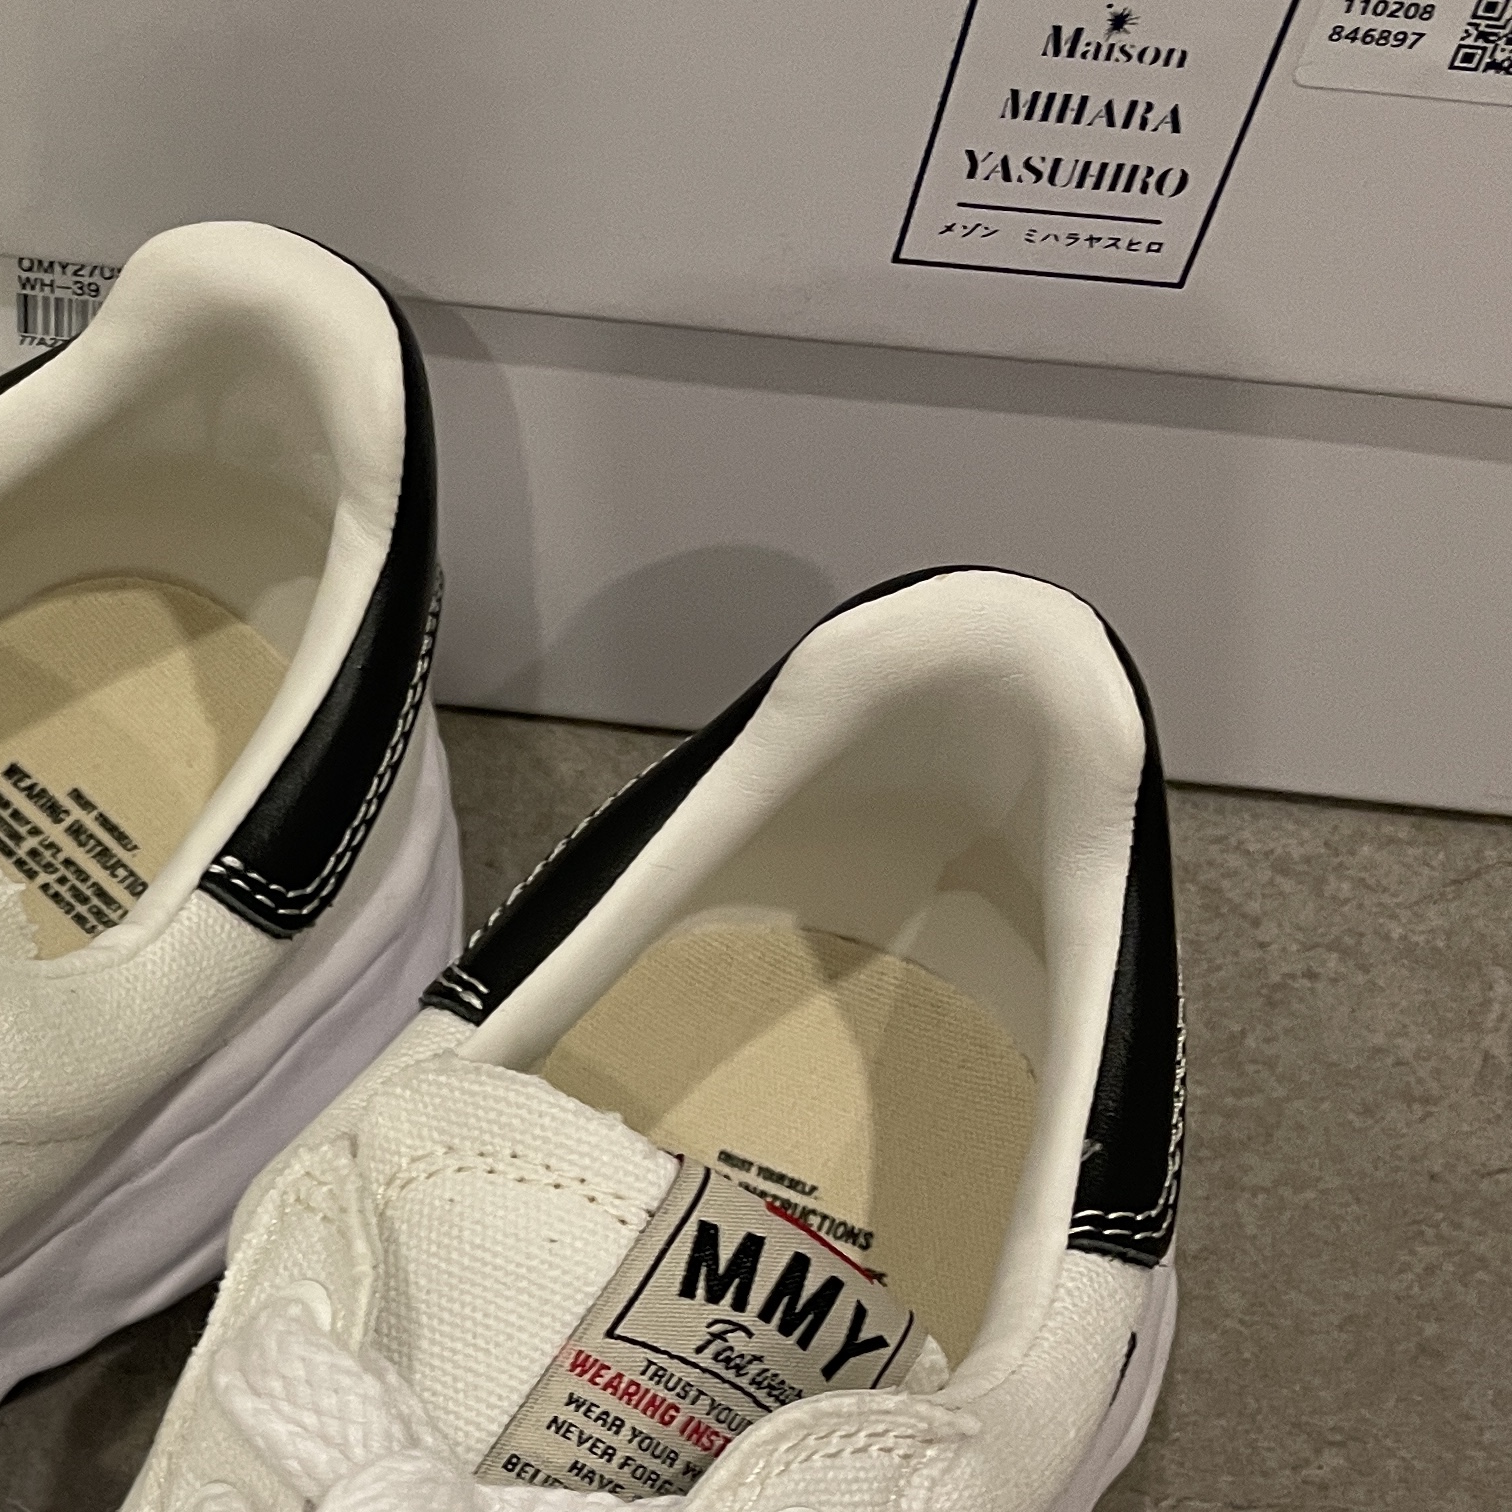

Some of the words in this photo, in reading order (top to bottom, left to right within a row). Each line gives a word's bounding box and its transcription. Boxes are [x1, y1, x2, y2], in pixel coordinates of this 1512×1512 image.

[1344, 0, 1437, 22] 110208
[1040, 24, 1189, 69] Maison
[1327, 24, 1427, 50] 846897
[999, 87, 1182, 135] MIHARA
[962, 148, 1190, 199] YASUHIRO
[937, 221, 1001, 239] メゾン
[1023, 227, 1165, 254] ミハラヤスヒロ
[1, 762, 71, 825] WEARING
[64, 818, 150, 900] INSTRUCTIO
[677, 1218, 891, 1383] MMY
[567, 1348, 682, 1428] WEARING
[678, 1414, 733, 1459] INST
[639, 1357, 712, 1406] TRUST
[545, 1415, 618, 1464] NEVER
[564, 1391, 626, 1436] WEAR
[626, 1425, 679, 1469] YOUR
